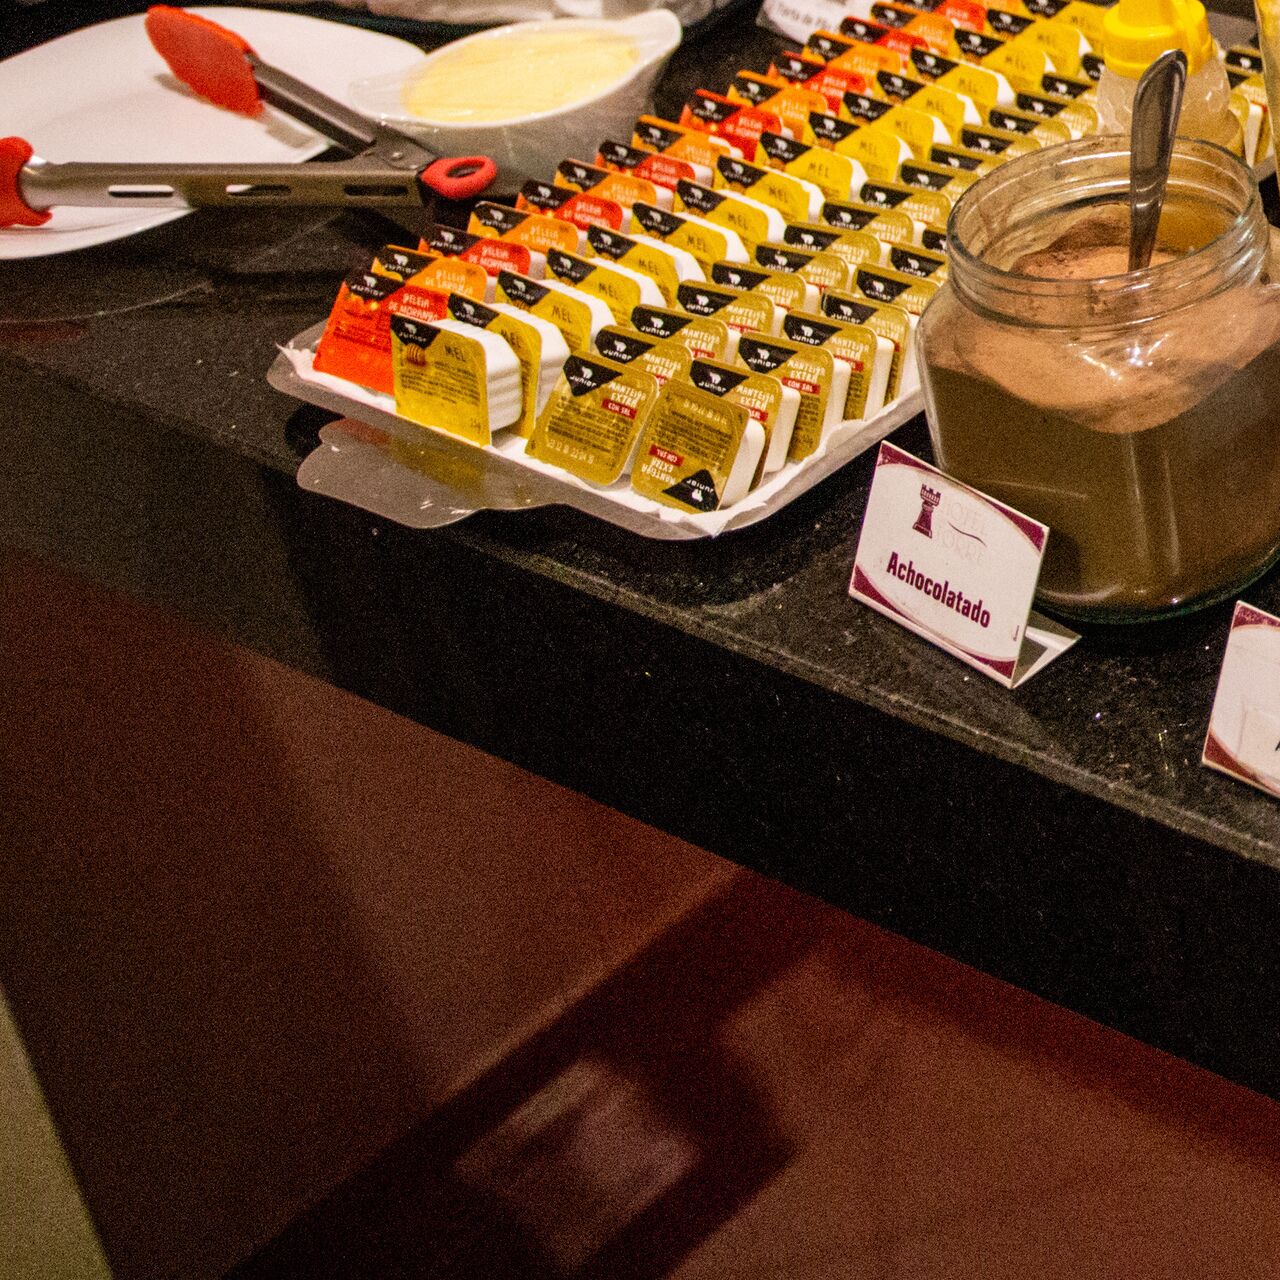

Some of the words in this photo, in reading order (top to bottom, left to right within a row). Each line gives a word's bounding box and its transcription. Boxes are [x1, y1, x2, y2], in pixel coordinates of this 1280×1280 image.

[598, 282, 619, 300] MEL
[552, 305, 572, 324] MEL
[444, 344, 466, 363] MEL
[887, 552, 991, 628] Achocolatado
